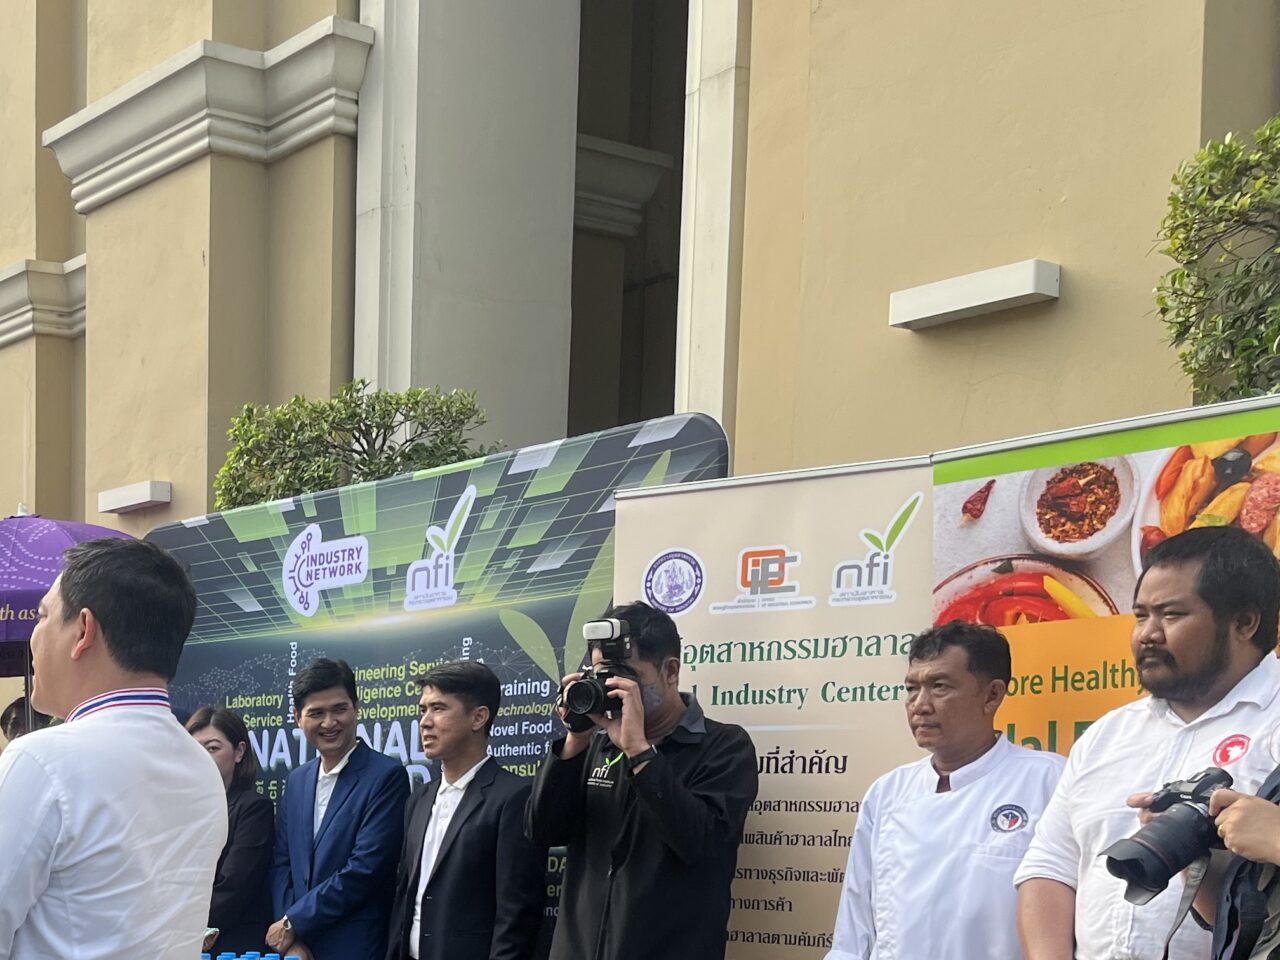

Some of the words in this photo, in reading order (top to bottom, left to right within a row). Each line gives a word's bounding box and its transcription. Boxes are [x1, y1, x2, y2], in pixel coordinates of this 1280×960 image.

[307, 546, 363, 568] INDUSTRY
[306, 561, 362, 582] NETWORK
[412, 553, 451, 592] nfi
[836, 552, 890, 589] nfi
[18, 608, 36, 620] as
[289, 642, 297, 676] Food
[354, 664, 406, 681] ineering
[1007, 674, 1043, 696] ore
[1052, 658, 1142, 695] Health
[357, 685, 402, 704] ligence
[500, 678, 550, 697] raining
[710, 683, 809, 710] Industry
[821, 681, 905, 703] Center
[225, 693, 283, 709] Laboratory
[497, 702, 555, 717] echnology
[243, 713, 283, 728] Service
[357, 702, 420, 721] evelopme
[522, 720, 553, 735] Food
[486, 741, 541, 757] Authentic
